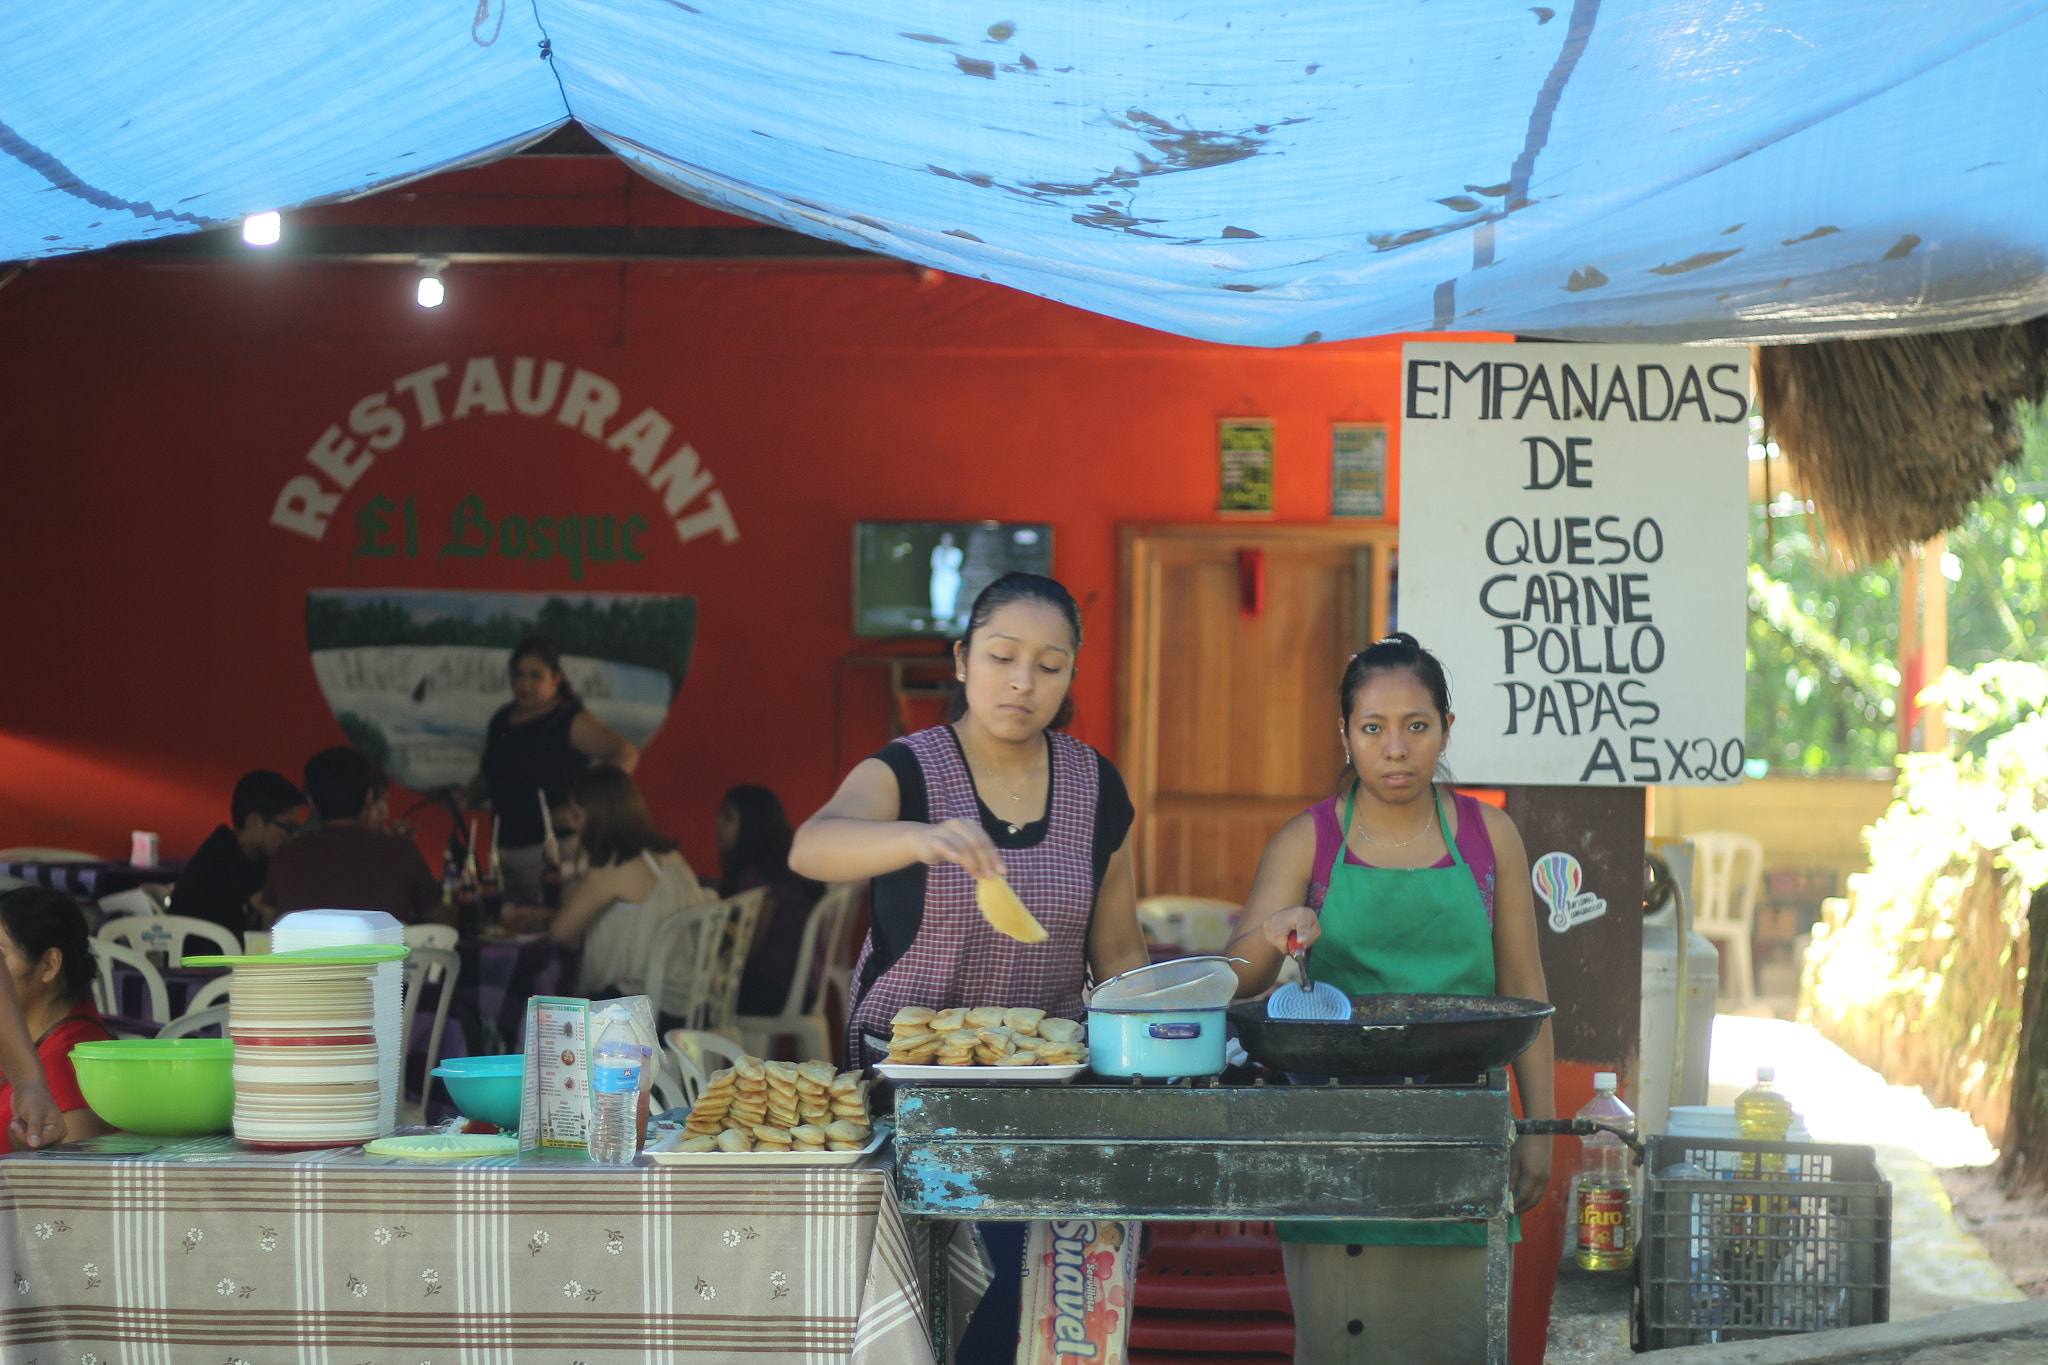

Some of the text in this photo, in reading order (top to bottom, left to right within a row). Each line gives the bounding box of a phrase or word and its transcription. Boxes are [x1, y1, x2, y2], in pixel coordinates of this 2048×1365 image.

[1406, 360, 1748, 424] EMPANADAS
[269, 356, 741, 545] RESTAURANT
[1521, 436, 1594, 490] DE
[351, 491, 650, 582] El Bosque
[1485, 516, 1664, 566] QUESO
[1479, 571, 1653, 625] CARNE
[1496, 624, 1665, 675] POLLO
[1495, 680, 1660, 736] PAPAS
[1051, 1221, 1097, 1357] Suavel
[1086, 1263, 1097, 1312] Servilleta
